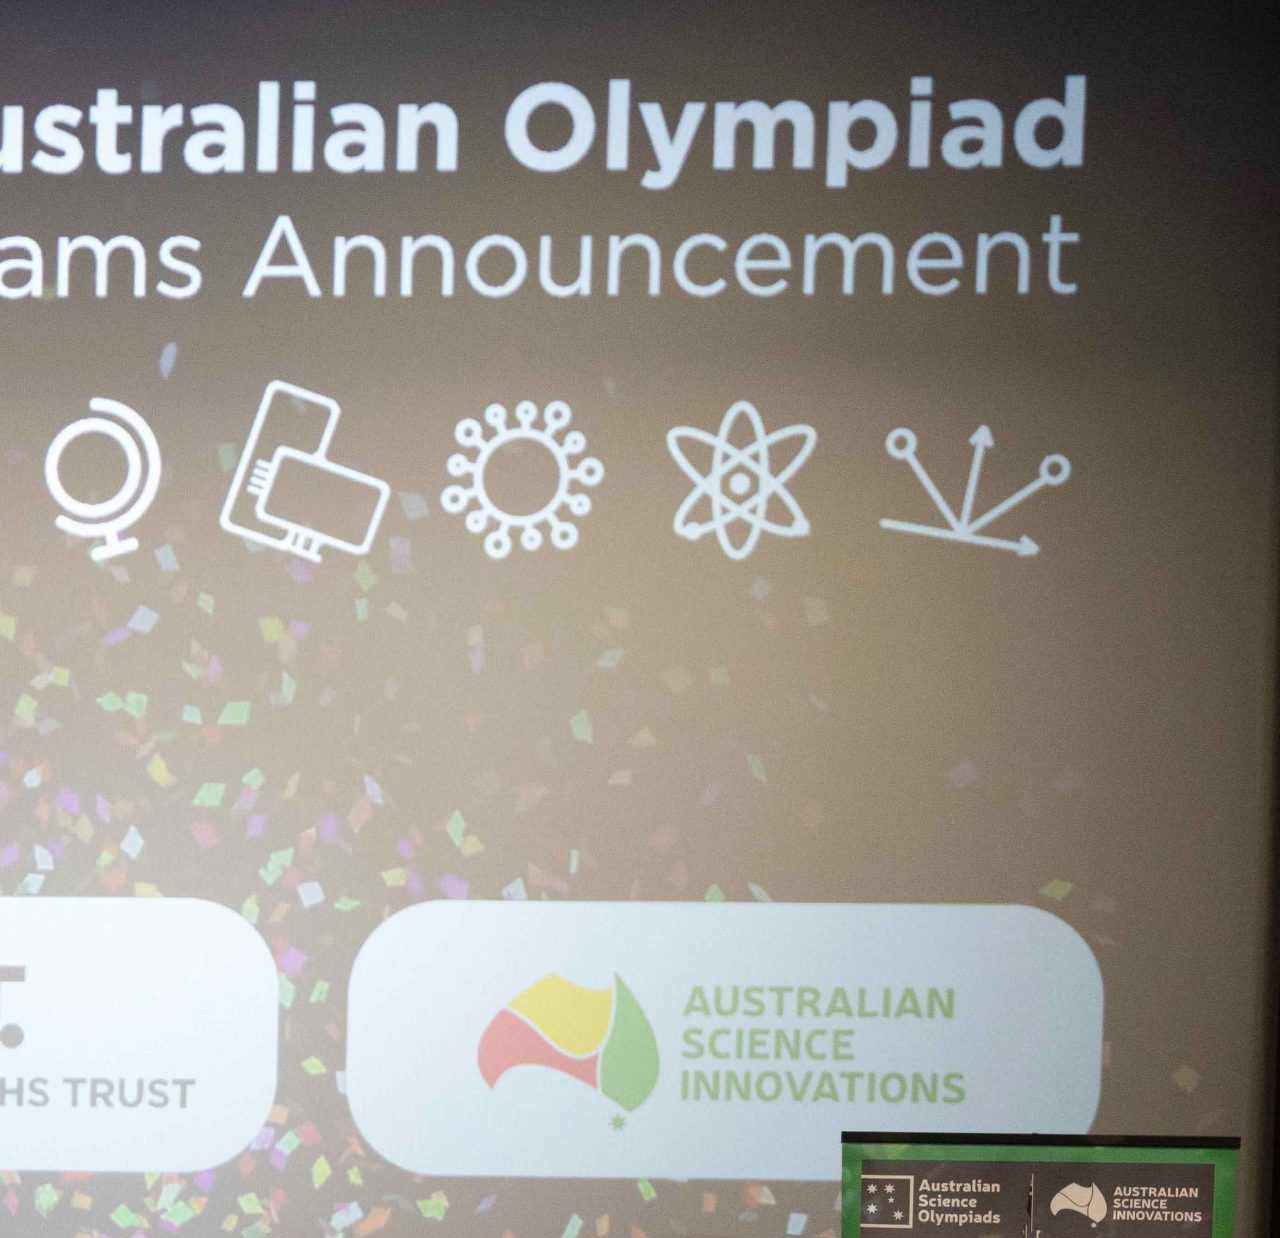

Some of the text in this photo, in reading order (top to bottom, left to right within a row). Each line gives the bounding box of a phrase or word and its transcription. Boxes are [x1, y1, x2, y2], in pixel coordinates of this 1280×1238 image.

[505, 77, 1084, 190] Olympiad
[243, 215, 1077, 298] Announcement
[683, 986, 955, 1018] AUSTRALIAN
[682, 1028, 855, 1061] SCIENCE
[63, 1077, 197, 1109] TRUST
[681, 1070, 966, 1104] INNOVATIONS
[918, 1178, 1001, 1194] Australian
[1113, 1186, 1199, 1198] AUSTRALIAN
[918, 1194, 978, 1208] Science
[1113, 1198, 1168, 1210] SCIENCE
[917, 1209, 1001, 1227] Olympiads
[1112, 1210, 1203, 1223] INNOVATIONS
